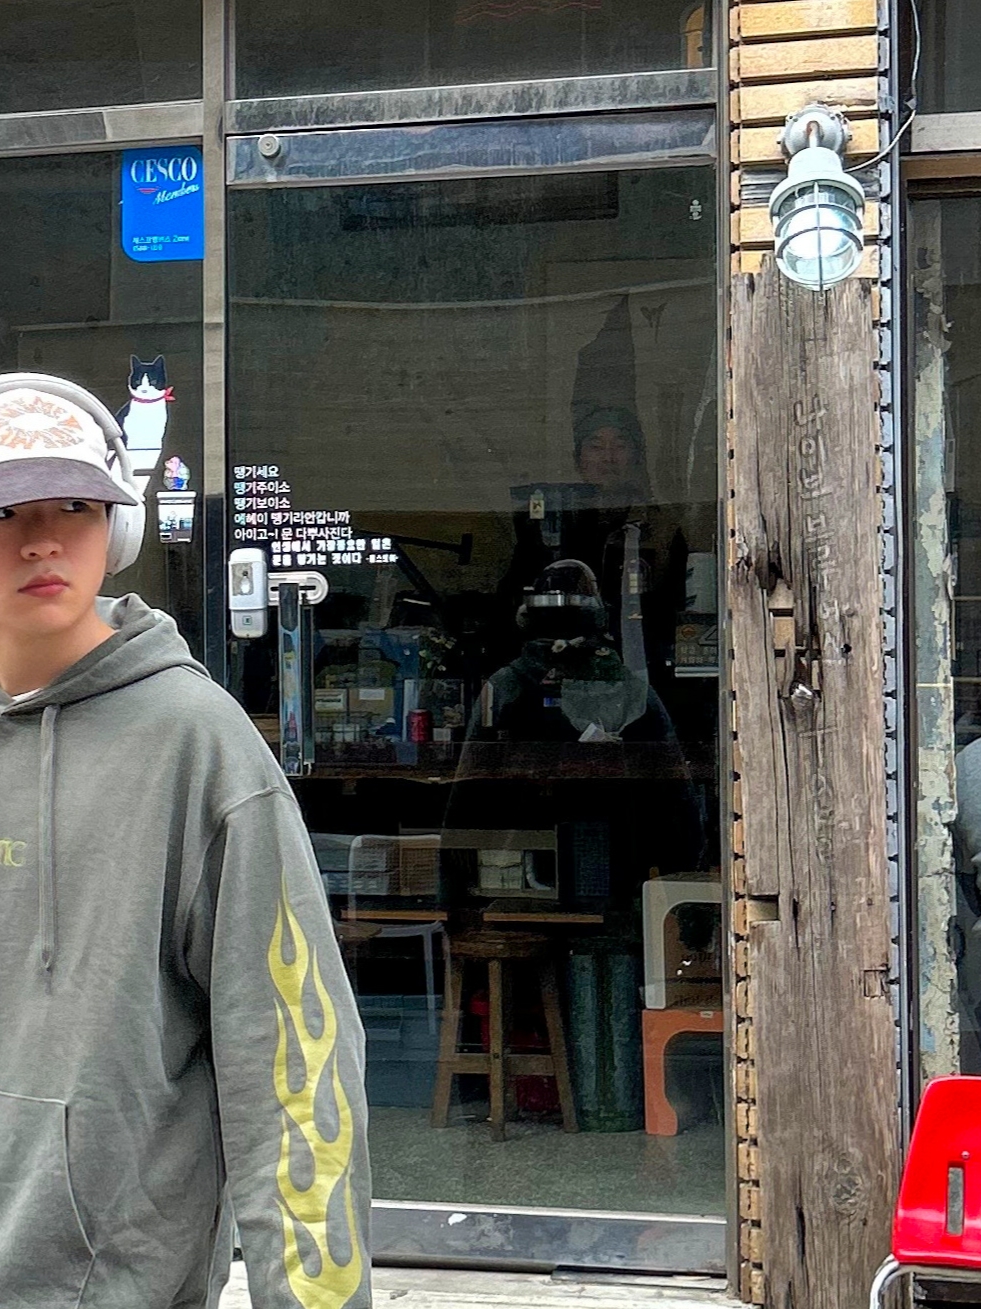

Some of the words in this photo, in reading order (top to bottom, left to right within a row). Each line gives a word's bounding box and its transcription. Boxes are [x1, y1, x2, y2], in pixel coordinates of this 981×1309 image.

[130, 156, 198, 183] CESCO
[233, 465, 280, 479] 땡기세요
[233, 481, 291, 495] 땡기주이소
[233, 497, 291, 510] 땡기보이소
[280, 528, 293, 541] 문
[295, 526, 353, 541] 다뿌사진다
